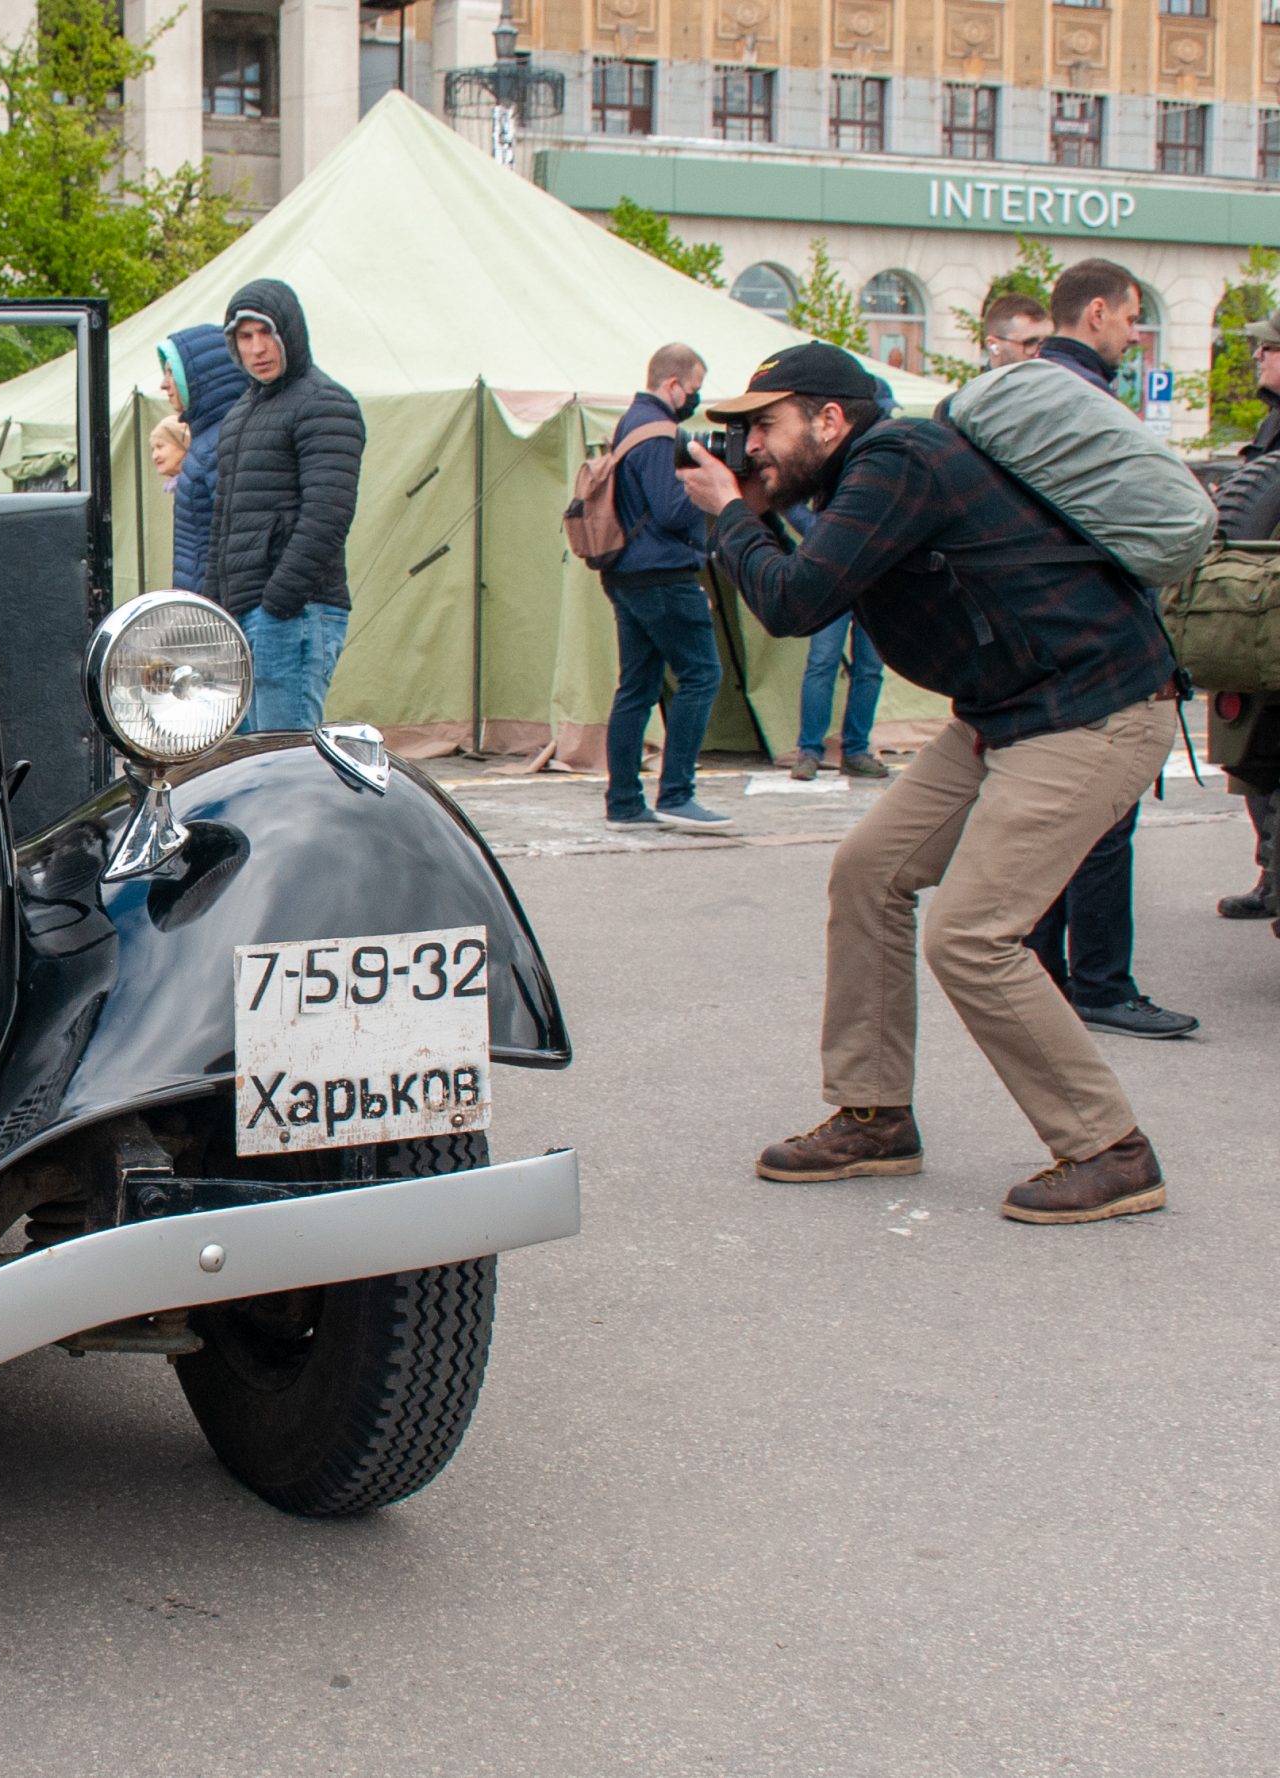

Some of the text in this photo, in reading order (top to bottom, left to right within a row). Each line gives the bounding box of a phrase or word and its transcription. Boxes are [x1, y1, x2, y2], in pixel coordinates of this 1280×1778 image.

[930, 180, 1135, 228] INTERTOP
[1152, 373, 1169, 400] P
[247, 939, 487, 1010] 7-59-32
[246, 1066, 479, 1137] Харьков
